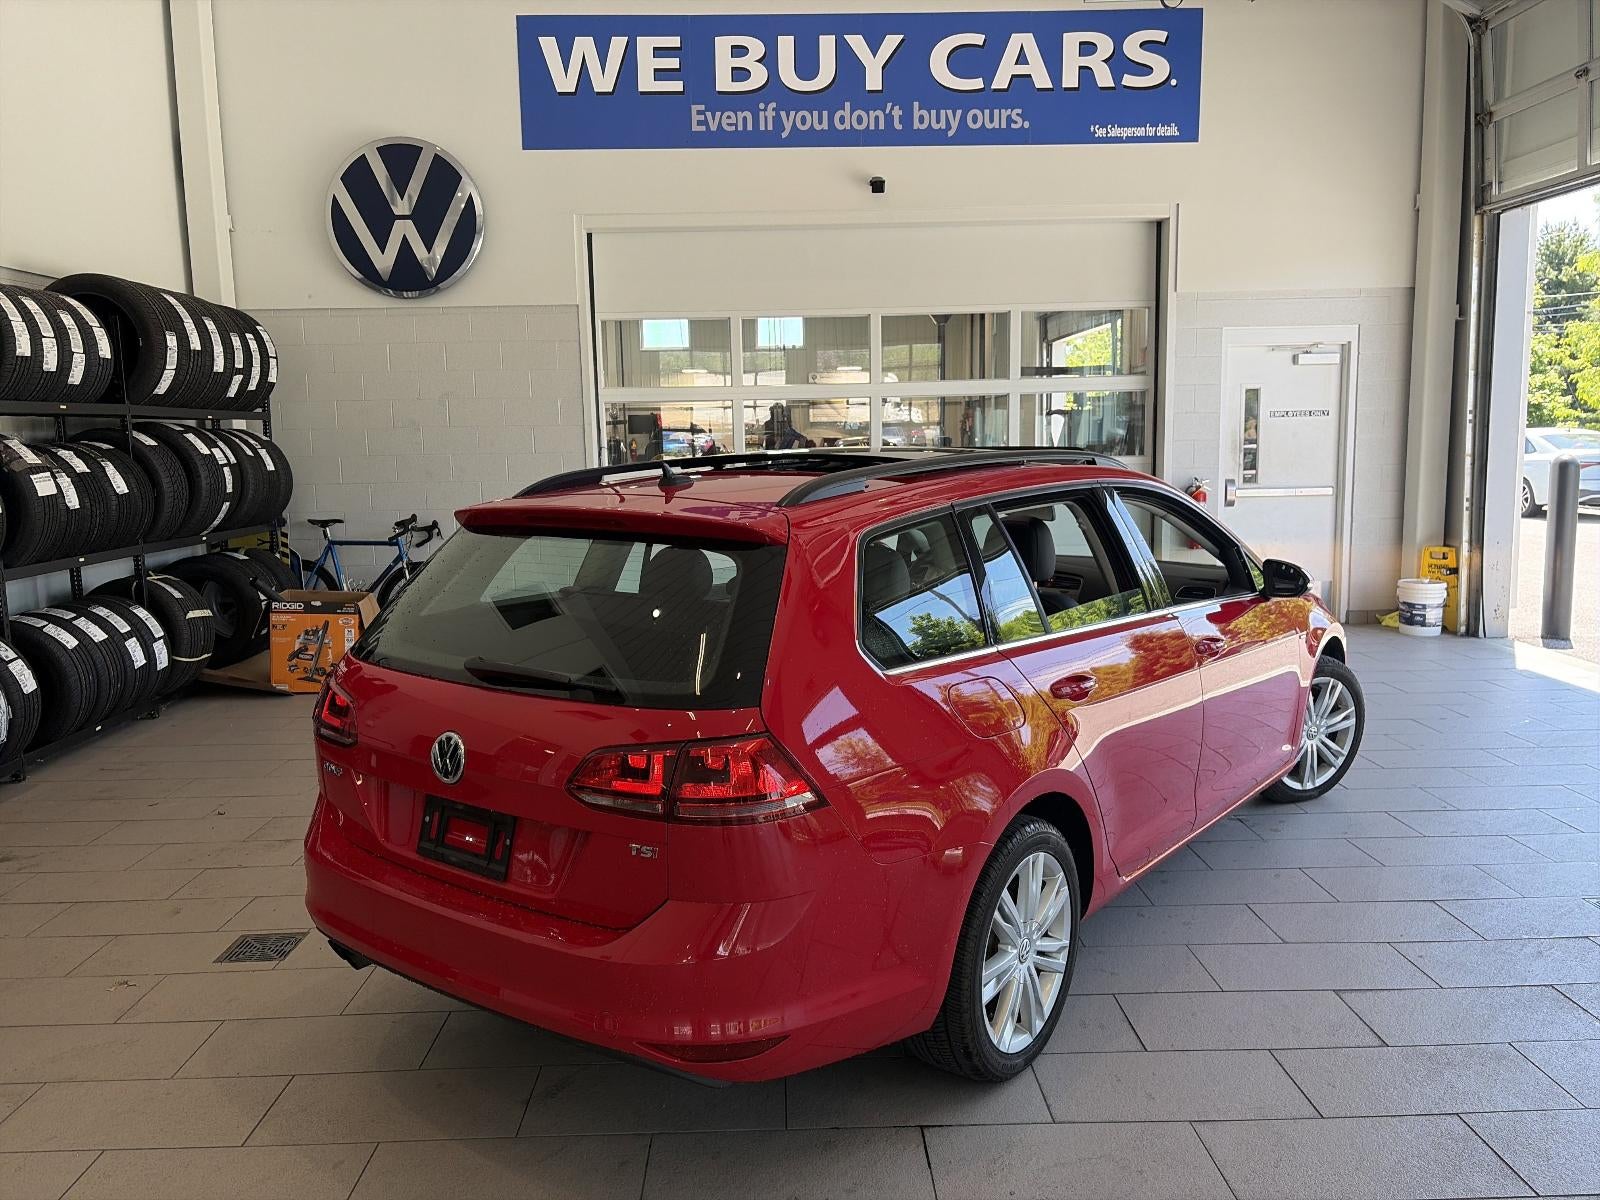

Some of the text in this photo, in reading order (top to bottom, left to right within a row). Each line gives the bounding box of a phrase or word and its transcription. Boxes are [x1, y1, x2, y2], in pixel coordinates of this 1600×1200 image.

[536, 29, 1178, 94] WE BUY CARS.
[690, 104, 753, 131] Even
[758, 101, 777, 131] if
[779, 110, 829, 139] you
[912, 101, 962, 137] buy
[966, 108, 1030, 129] ours.
[1107, 123, 1146, 140] Salesperson
[1145, 123, 1156, 137] for
[1156, 122, 1180, 137] details.
[1269, 409, 1330, 418] EMPLOYEES ONLY
[271, 601, 305, 610] RIDGID
[629, 843, 659, 859] TSI
